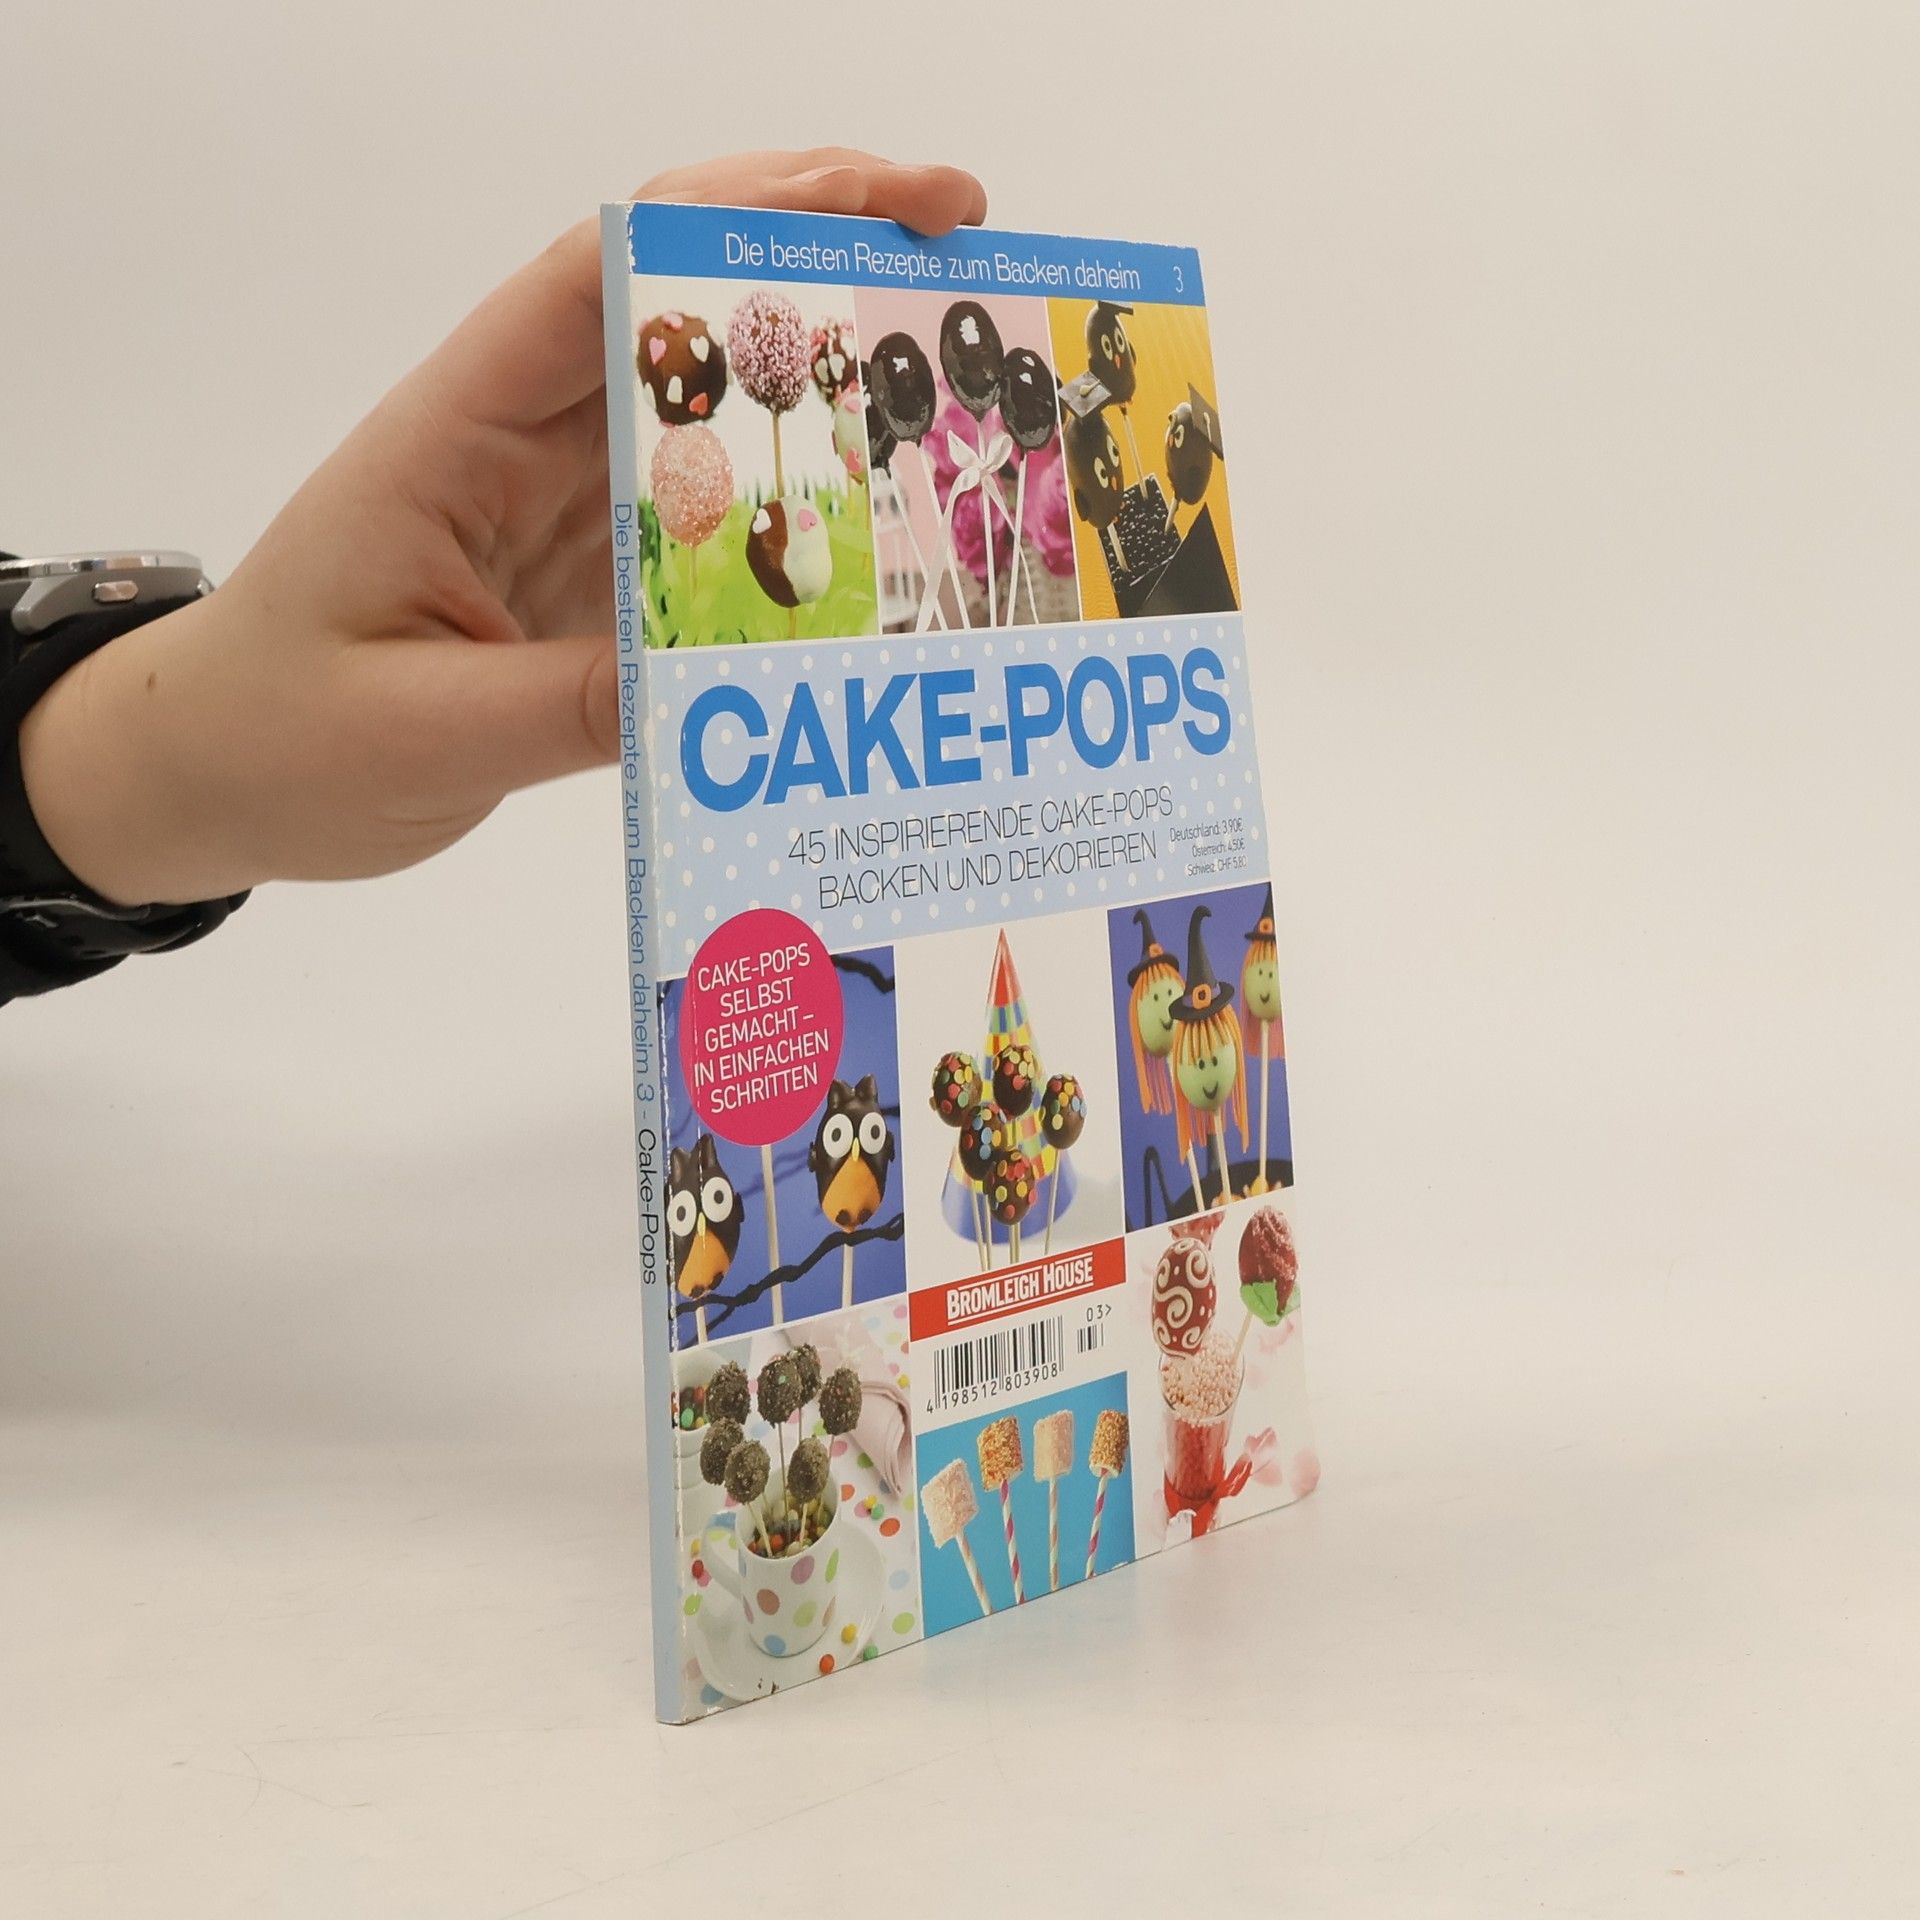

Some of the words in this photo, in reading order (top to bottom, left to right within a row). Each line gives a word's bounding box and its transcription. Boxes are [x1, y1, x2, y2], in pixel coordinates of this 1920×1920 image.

[725, 232, 764, 266] Die
[770, 235, 849, 271] besten
[854, 242, 942, 283] Rezepte
[948, 256, 991, 281] zum
[994, 253, 1070, 286] Backen
[1075, 260, 1141, 290] daheim
[1173, 266, 1184, 293] 3
[614, 504, 632, 548] Die
[616, 557, 635, 653] besten
[621, 663, 640, 780] Rezepte
[680, 647, 1232, 813] CAKE-POPS
[625, 791, 641, 848] zum
[788, 830, 826, 865] 45
[835, 804, 1034, 860] INSPIRIERENDE
[1040, 785, 1173, 833] CAKE-POPS
[819, 861, 938, 909] BACKEN
[947, 853, 1002, 891] UND
[1009, 830, 1157, 882] DEKORIEREN
[1217, 859, 1231, 871] CHF
[628, 859, 648, 964] Backen
[697, 942, 810, 991] CAKE-POPS
[720, 977, 794, 1017] SELBST
[632, 973, 652, 1074] daheim
[705, 1006, 799, 1052] GEMACHT
[694, 1059, 714, 1088] IN
[719, 1028, 829, 1081] EINFACHEN
[711, 1062, 818, 1113] SCHRITTEN
[636, 1083, 654, 1102] 3
[638, 1128, 659, 1285] Cake-Pops
[947, 1271, 1040, 1319] BROMLEIGH
[1043, 1257, 1093, 1293] HOUSE
